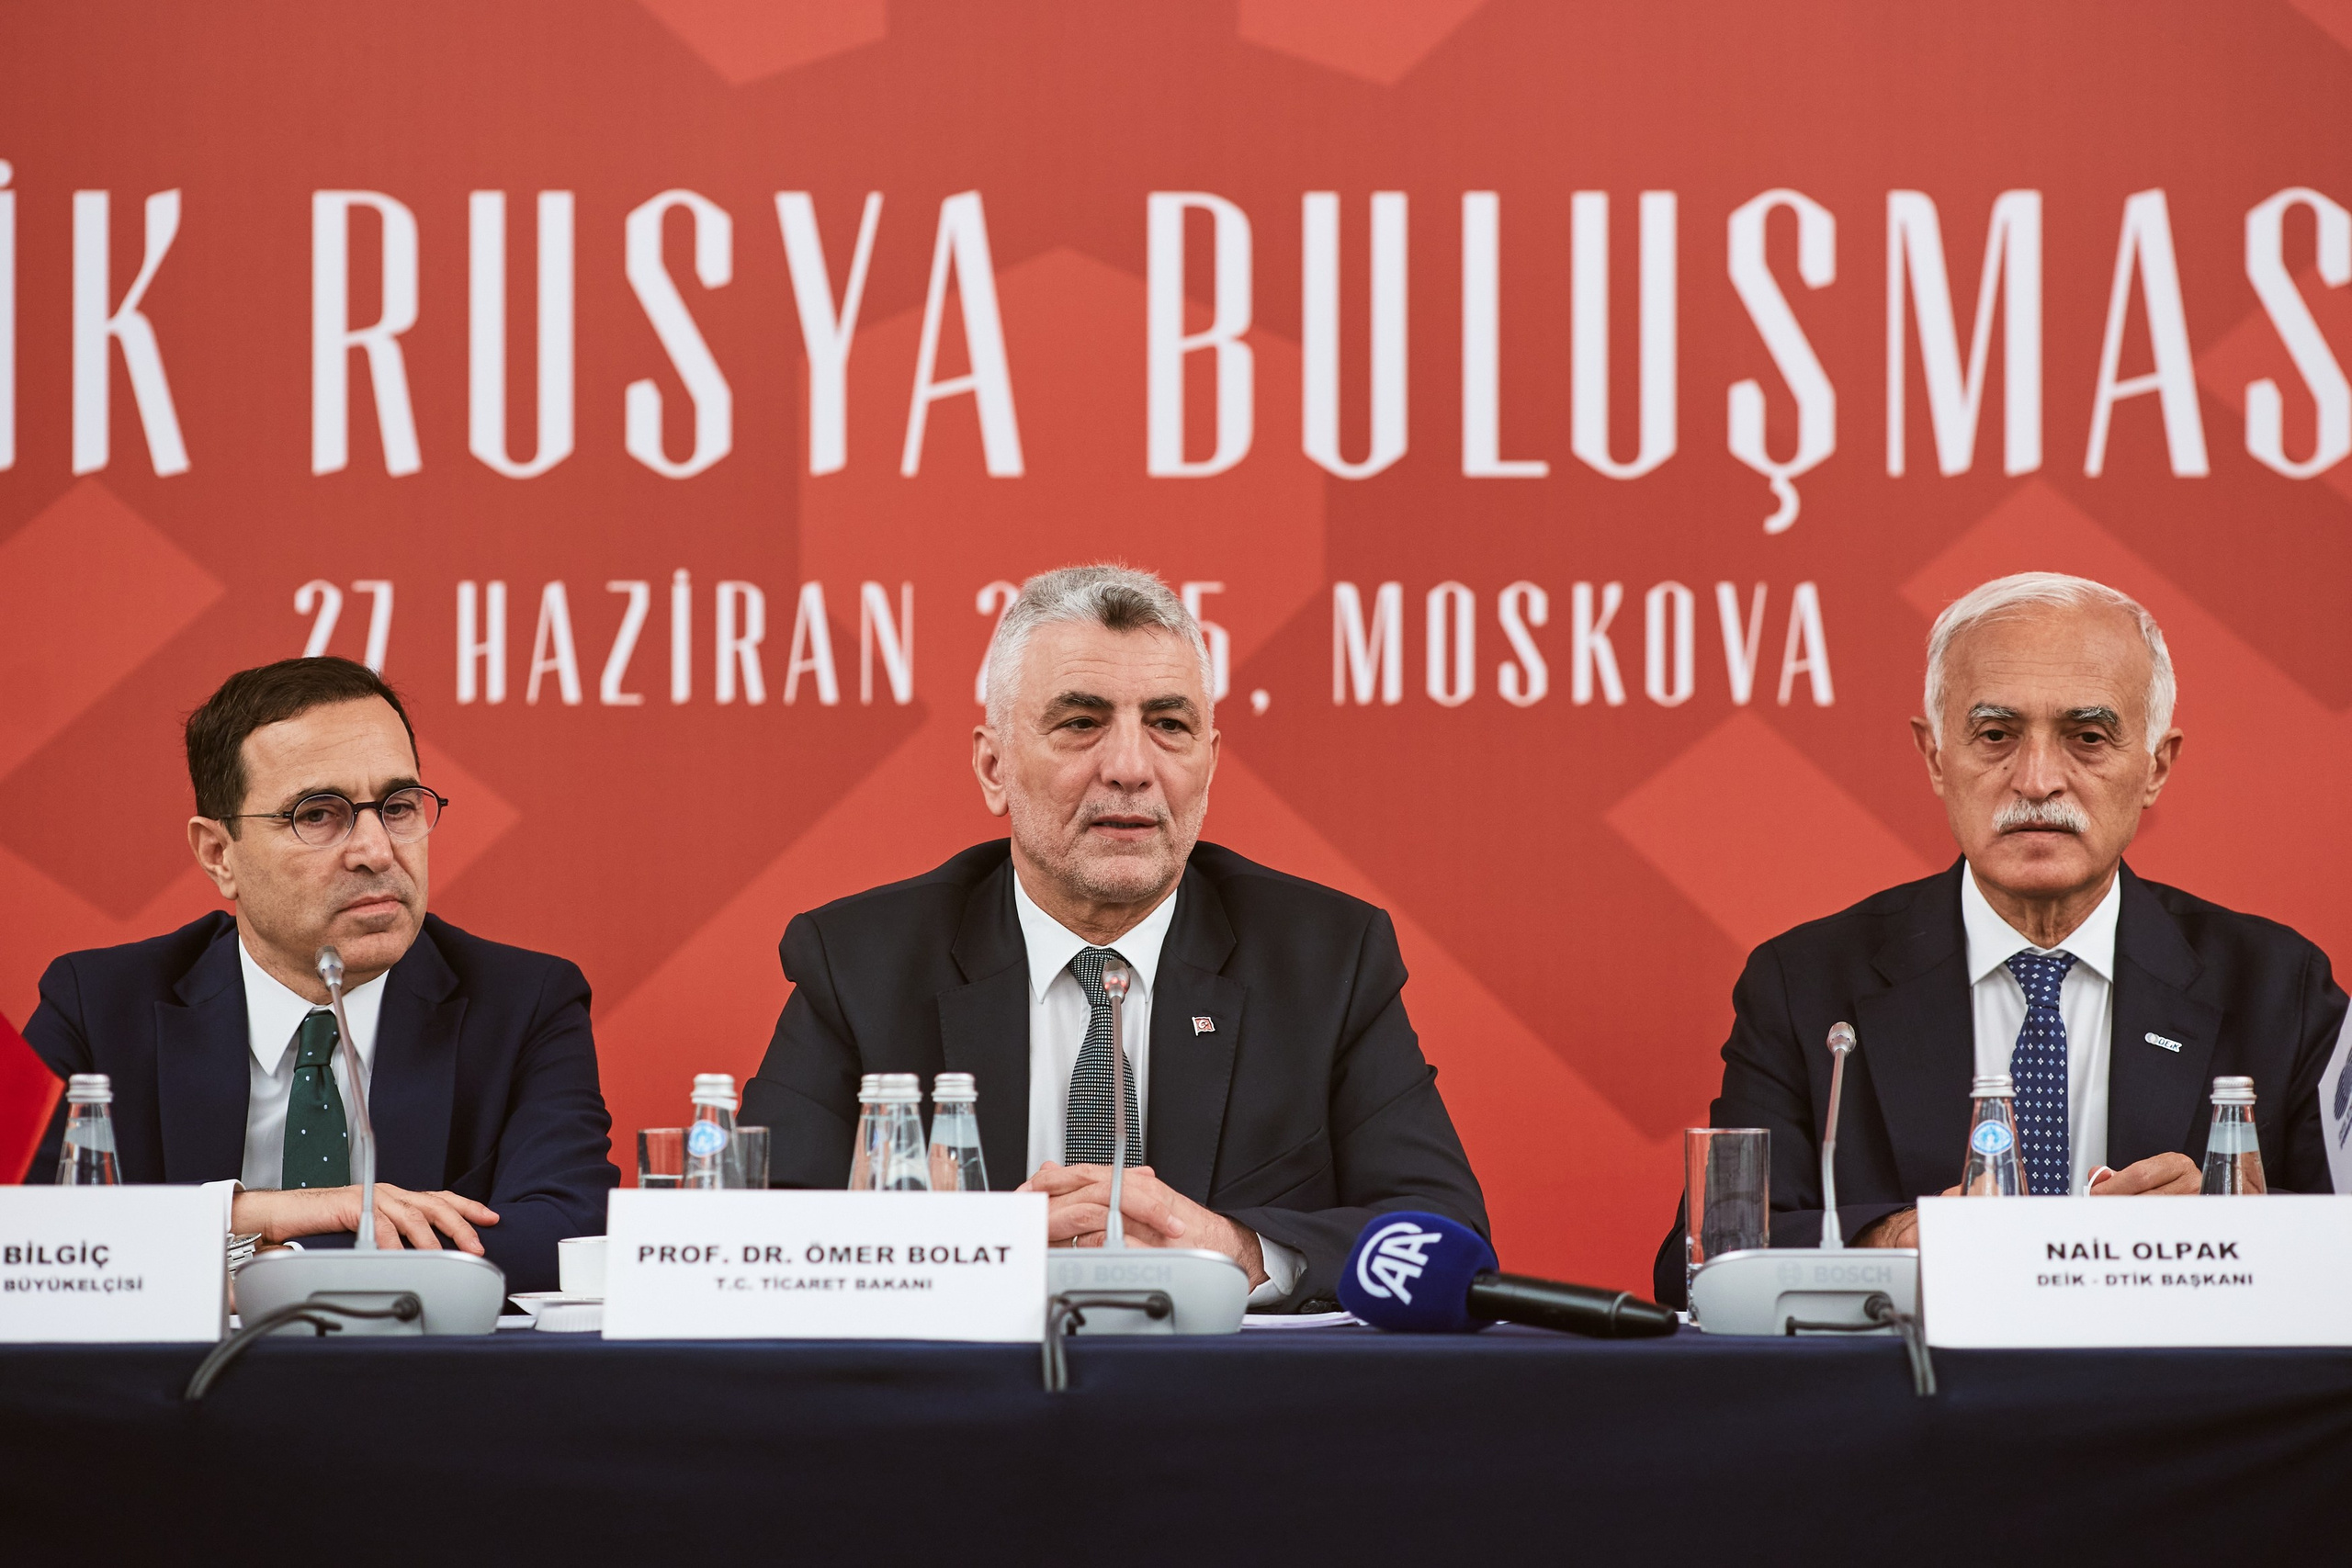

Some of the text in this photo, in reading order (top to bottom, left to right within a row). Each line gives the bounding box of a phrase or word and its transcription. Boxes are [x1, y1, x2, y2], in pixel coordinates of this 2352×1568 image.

[311, 188, 1024, 479] RUSYA
[1147, 187, 2352, 534] BULUŞMAS
[294, 580, 394, 678] 27
[457, 569, 914, 705] HAZİRAN
[1333, 581, 1836, 706] MOSKOVA
[3, 1240, 109, 1269] BİLGİÇ
[638, 1241, 1012, 1265] PROF. DR. ÖMER BOLAT
[2045, 1237, 2240, 1261] NAİL OLPAK
[716, 1276, 933, 1291] T.C. TİCARET BAKANI
[1094, 1265, 1171, 1283] BOSCH
[1814, 1266, 1892, 1283] BOSCH
[2037, 1272, 2086, 1287] DEİK
[2105, 1272, 2153, 1287] DTİK
[2161, 1273, 2254, 1289] BAŞKANI
[3, 1276, 143, 1294] BÜYÜKELÇİSİ
